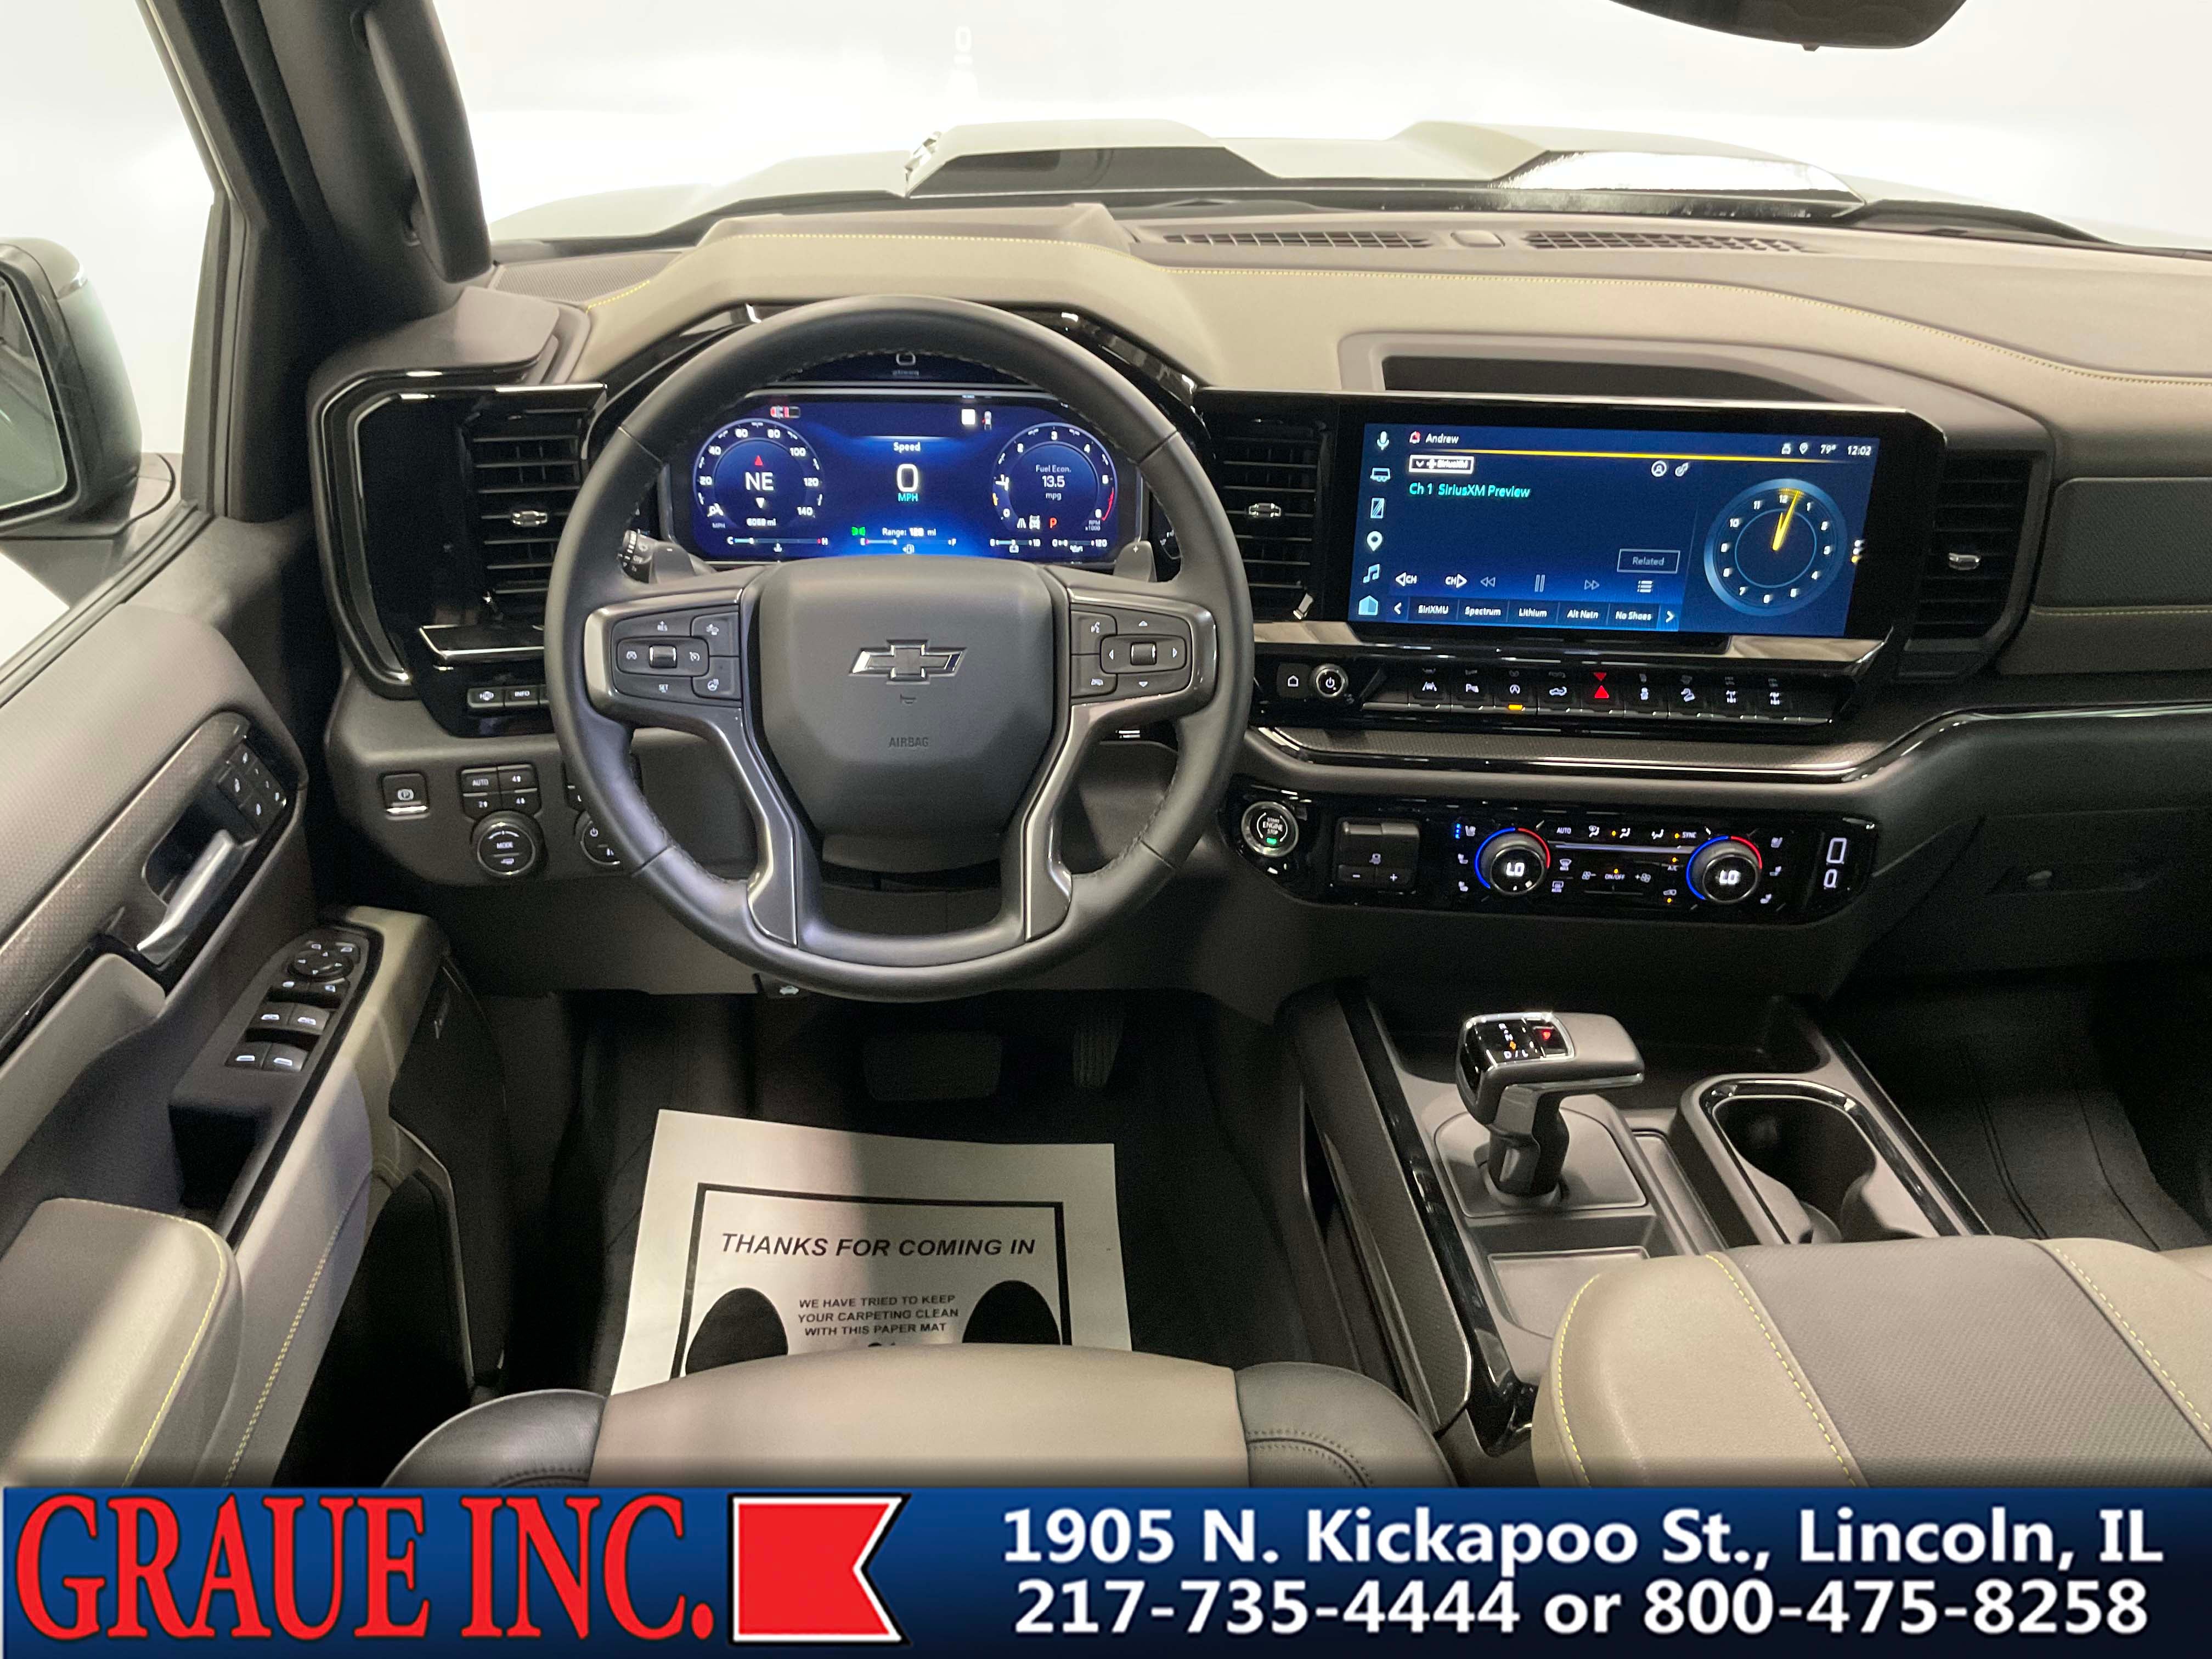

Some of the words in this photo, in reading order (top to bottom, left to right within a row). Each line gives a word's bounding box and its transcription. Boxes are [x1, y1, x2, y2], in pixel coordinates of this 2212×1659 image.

[1425, 433, 1459, 444] Andrew
[790, 447, 806, 456] 100
[893, 442, 921, 453] Speed
[1847, 445, 1872, 456] 12:02
[745, 471, 774, 491] NE
[804, 478, 819, 487] 120
[897, 464, 918, 492] 0
[1042, 475, 1065, 488] 13.5
[1409, 482, 1424, 495] Ch
[1427, 483, 1433, 494] 1
[1438, 483, 1485, 496] SiriusXM
[1487, 485, 1531, 498] Preview
[898, 493, 918, 502] MPH
[1045, 492, 1062, 500] mpg
[797, 507, 813, 516] 140
[1049, 517, 1057, 529] P
[882, 527, 906, 538] Range:
[1632, 556, 1664, 566] Related
[1406, 574, 1417, 584] CH
[1445, 576, 1457, 585] CH
[1465, 606, 1501, 617] Spectrum
[1519, 608, 1548, 618] Lithium
[1567, 610, 1578, 618] Alt
[1615, 611, 1627, 619] No
[888, 737, 929, 747] AIRBAG
[1262, 821, 1283, 832] ENGINE
[721, 1233, 828, 1256] THANKS
[835, 1238, 891, 1256] FOR
[898, 1238, 1002, 1256] COMING
[1010, 1238, 1036, 1255] IN
[799, 1299, 819, 1308] WE
[823, 1298, 856, 1308] HAVE
[861, 1296, 898, 1307] TRIED
[901, 1295, 918, 1305] TO
[922, 1295, 956, 1305] KEEP
[798, 1312, 834, 1323] YOUR
[837, 1310, 912, 1322] CARPETING
[915, 1308, 959, 1319] CLEAN
[805, 1327, 838, 1336] WITH
[841, 1325, 870, 1335] THIS
[873, 1323, 917, 1334] PAPER
[920, 1322, 947, 1332] MAT
